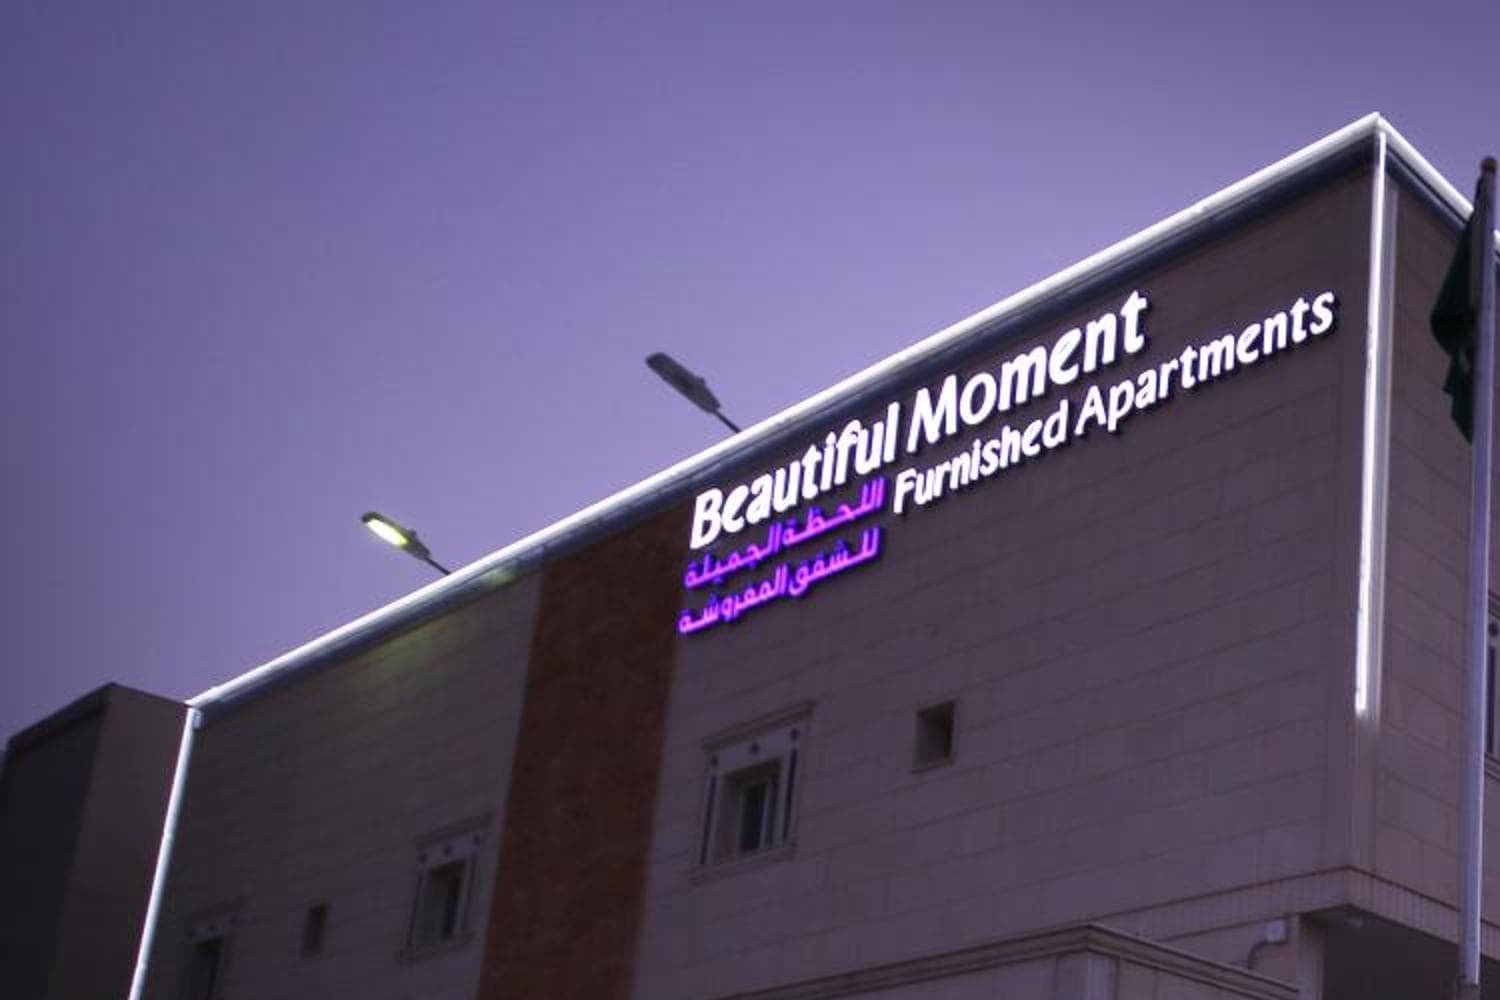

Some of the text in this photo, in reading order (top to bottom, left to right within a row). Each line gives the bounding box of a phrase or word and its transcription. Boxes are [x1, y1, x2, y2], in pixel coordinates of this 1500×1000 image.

[690, 290, 1148, 549] Beautiful Moment
[893, 291, 1335, 514] Furnished Apartments
[678, 525, 881, 633] للشقق المفروشة
[684, 476, 886, 589] اللحظة الجميلة
